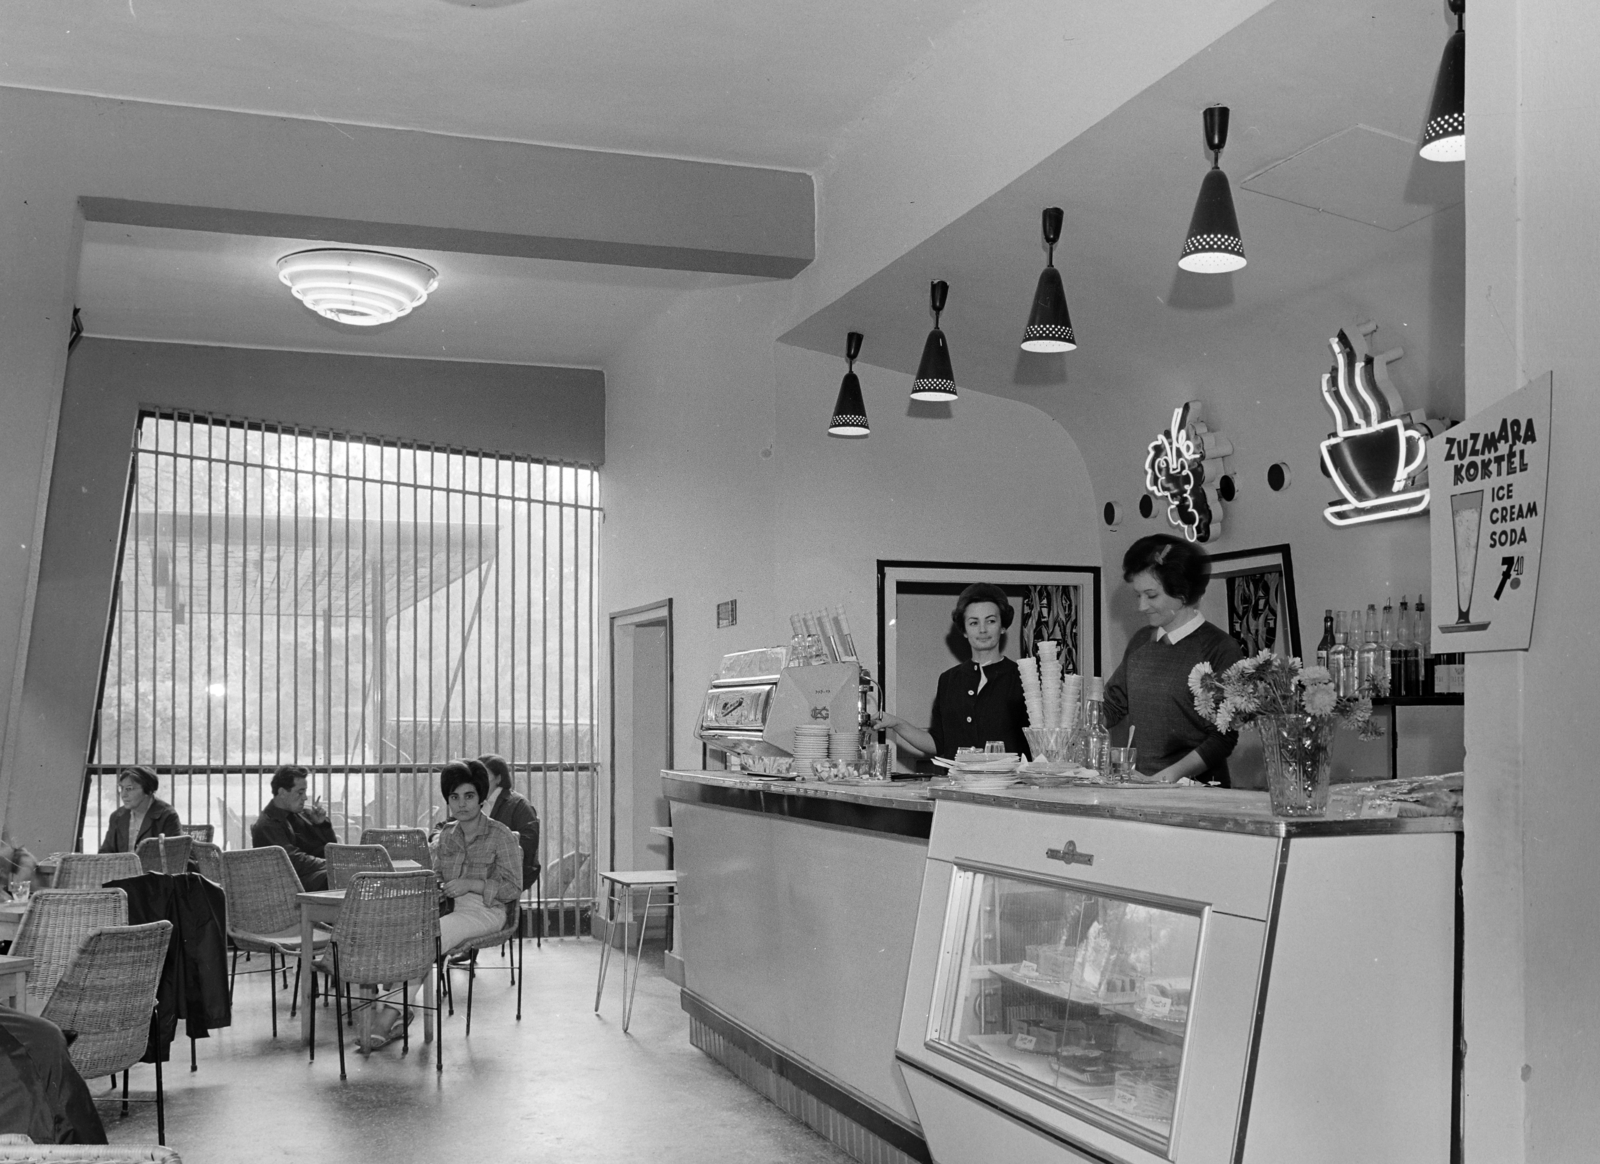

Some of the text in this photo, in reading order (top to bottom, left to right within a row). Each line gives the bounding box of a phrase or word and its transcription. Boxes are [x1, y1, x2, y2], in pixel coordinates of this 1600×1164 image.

[1444, 418, 1537, 461] ZUZMARA
[1453, 444, 1529, 486] KOKTÉL
[1491, 483, 1513, 503] ICE
[1489, 501, 1538, 525] CREAM
[1489, 526, 1527, 549] SODA
